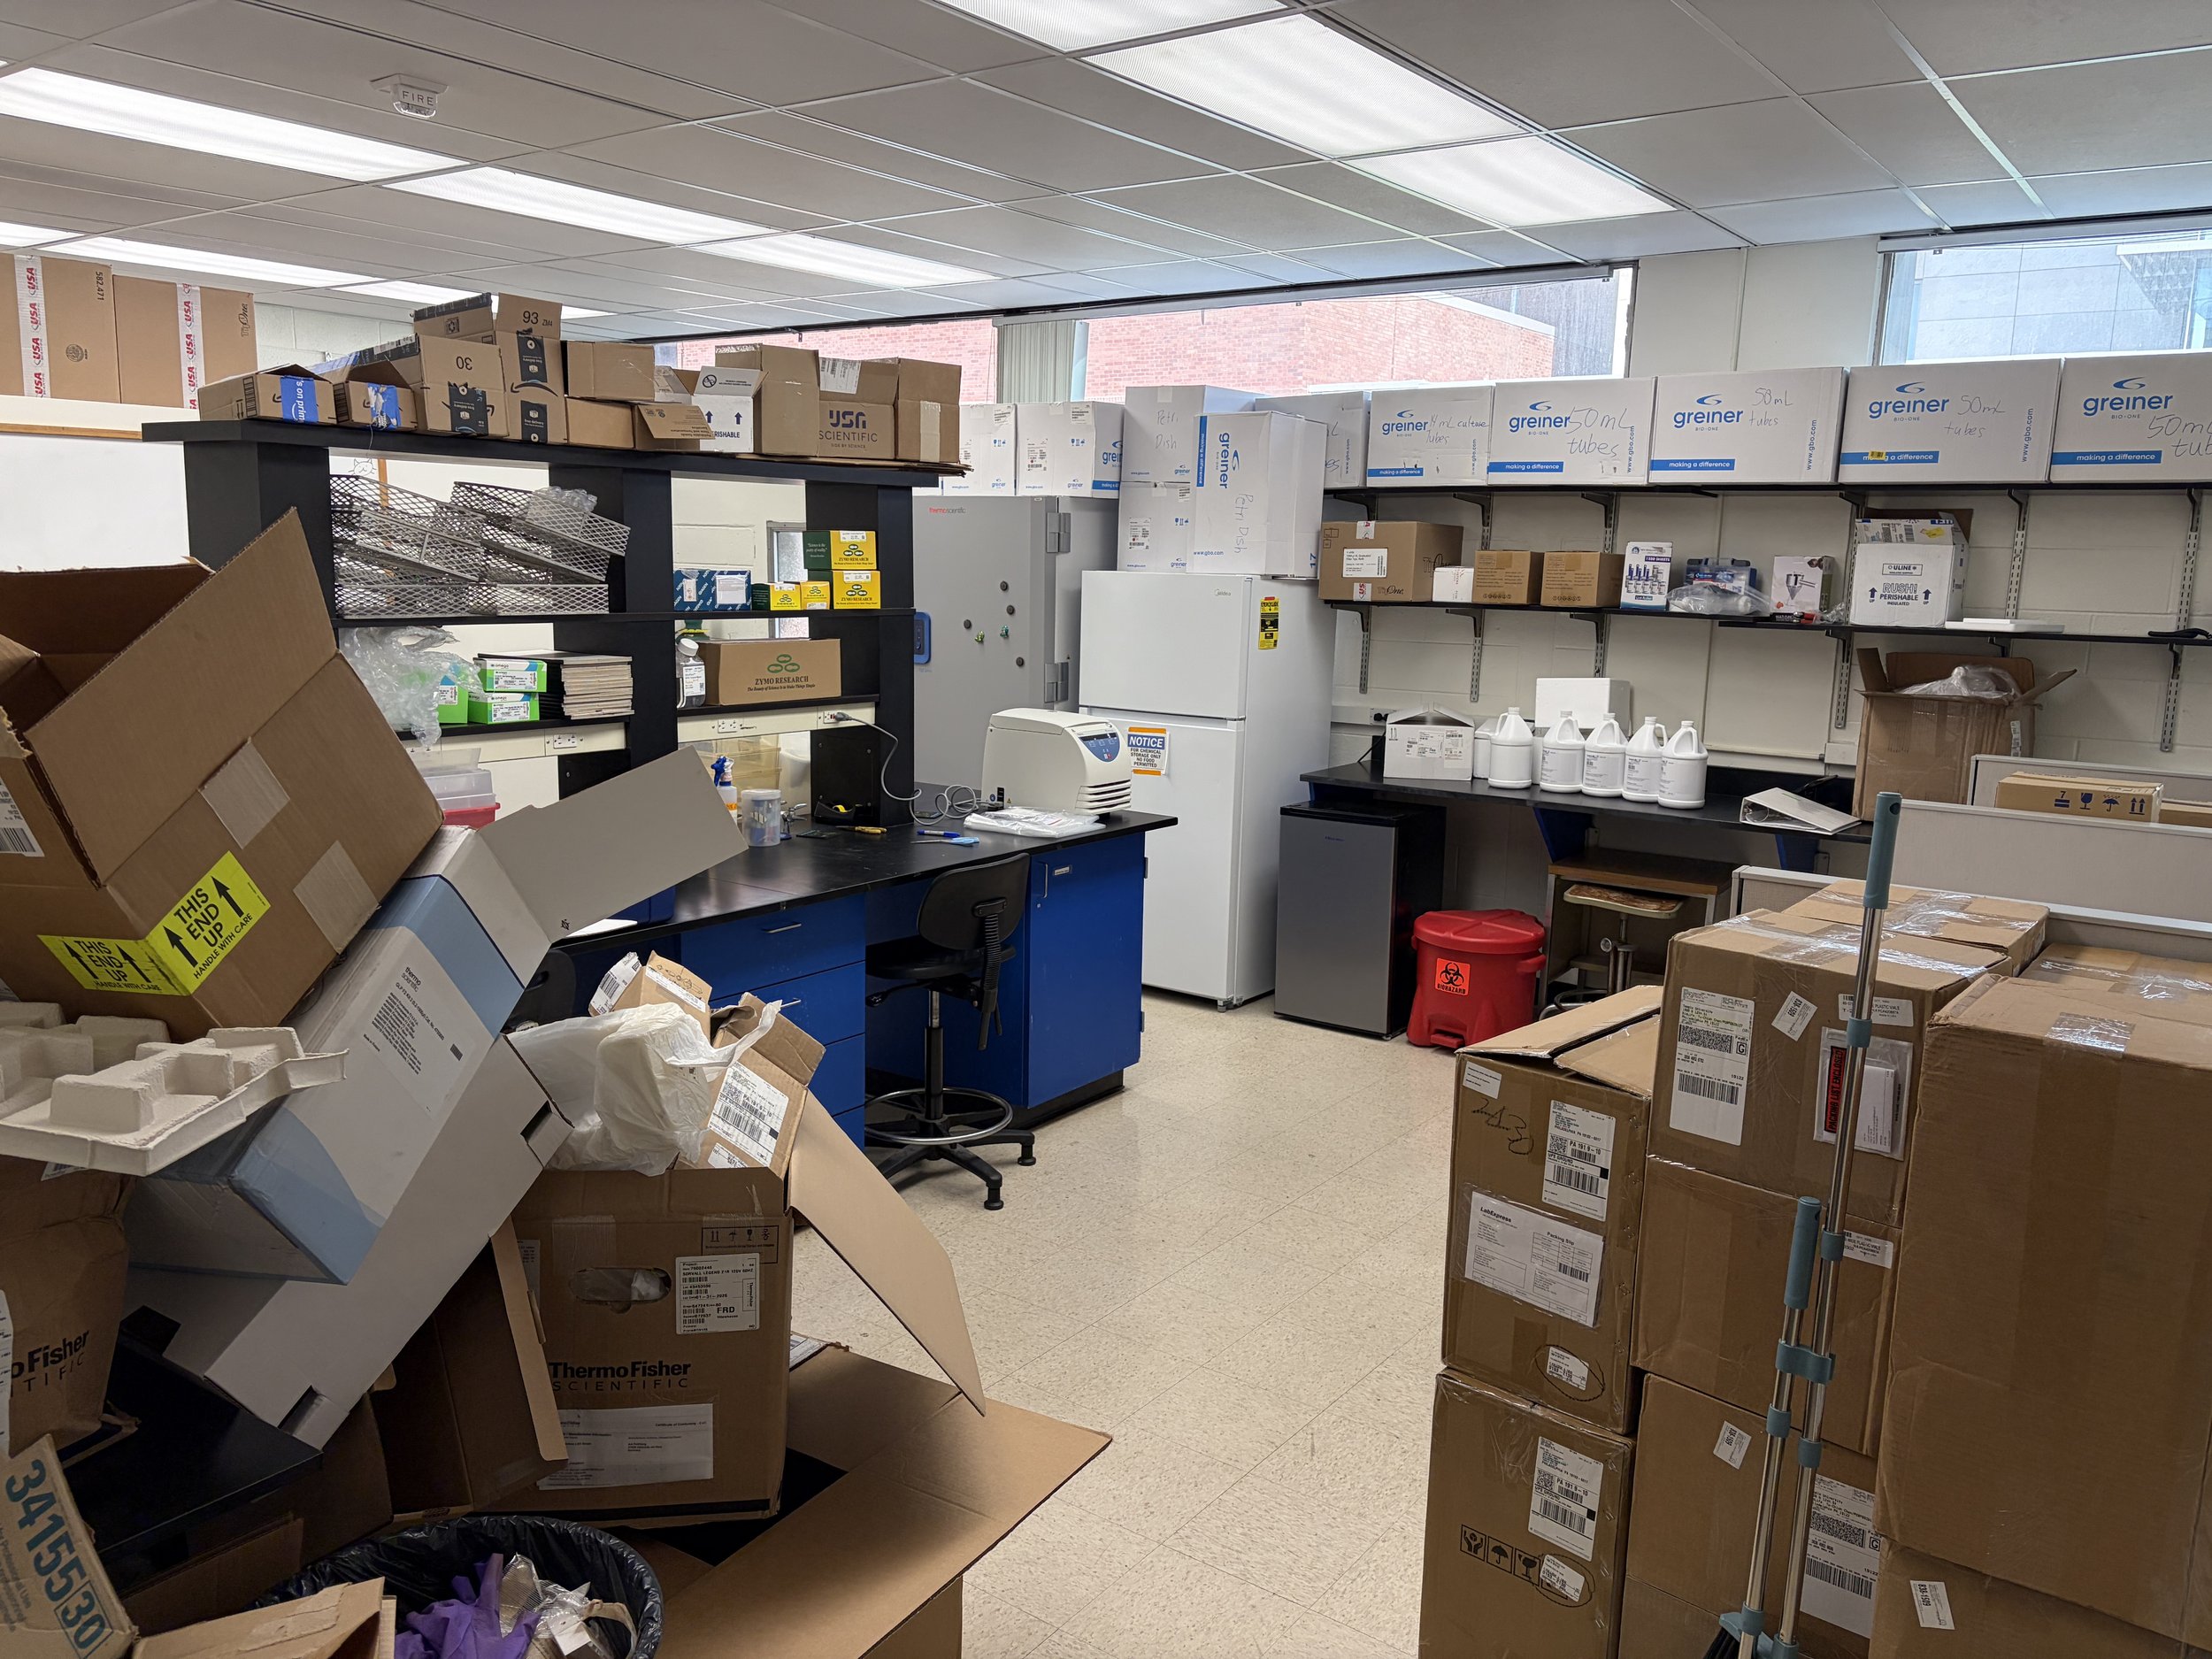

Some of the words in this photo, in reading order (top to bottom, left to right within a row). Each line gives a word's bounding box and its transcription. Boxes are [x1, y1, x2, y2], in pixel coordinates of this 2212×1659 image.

[402, 90, 434, 106] FIRE
[26, 267, 35, 290] USA
[95, 271, 104, 302] 582.471
[30, 303, 39, 326] USA
[522, 311, 539, 325] 93
[31, 337, 41, 360] USA
[456, 356, 473, 371] 30
[34, 372, 43, 396] USA
[187, 365, 196, 388] USA
[296, 388, 303, 399] on
[1869, 398, 1950, 419] greiner
[2083, 395, 2174, 418] greiner
[1509, 415, 1571, 433] greiner
[1673, 410, 1744, 429] greiner
[1748, 410, 1778, 426] tubes
[1381, 419, 1429, 435] greiner
[1944, 422, 1987, 439] tubes
[2021, 408, 2034, 463] www.gbo.com
[818, 430, 878, 442] SCIENTIFIC
[1155, 434, 1177, 450] Dish
[1567, 433, 1619, 458] tubes
[1626, 425, 1635, 473] www.gbo.com
[1806, 419, 1817, 471] www.gbo.com
[1218, 432, 1231, 489] greiner
[991, 480, 1007, 489] greiner
[1233, 526, 1249, 554] Dish
[1310, 552, 1317, 569] 17
[1882, 582, 1918, 595] RUSH!
[775, 675, 809, 685] RESEARCH
[1128, 736, 1164, 748] NOTICE
[2059, 790, 2067, 799] 7
[173, 887, 210, 926] THIS
[185, 902, 220, 941] END
[202, 921, 224, 949] UP
[73, 940, 112, 956] THIS
[193, 949, 221, 980] HANDLE
[217, 927, 236, 952] WITH
[233, 912, 254, 935] CARE
[86, 954, 124, 970] END
[104, 968, 128, 983] UP
[403, 965, 423, 987] thermo
[93, 980, 124, 991] HANDLE
[123, 981, 142, 991] WITH
[142, 982, 163, 992] CARE
[1437, 983, 1466, 995] BIOHAZARD
[1556, 1155, 1574, 1164] GROUND
[1479, 1206, 1512, 1223] LabExpress
[1547, 1231, 1564, 1244] Packing
[1564, 1238, 1576, 1247] Slip
[11, 1330, 89, 1379] oFisher
[551, 1378, 689, 1392] SCIENTIFIC
[1556, 1477, 1563, 1486] PA
[1564, 1479, 1573, 1489] 191
[1543, 1488, 1561, 1502] GROUND
[5, 1458, 88, 1603] 34155
[60, 1589, 107, 1650] 30
